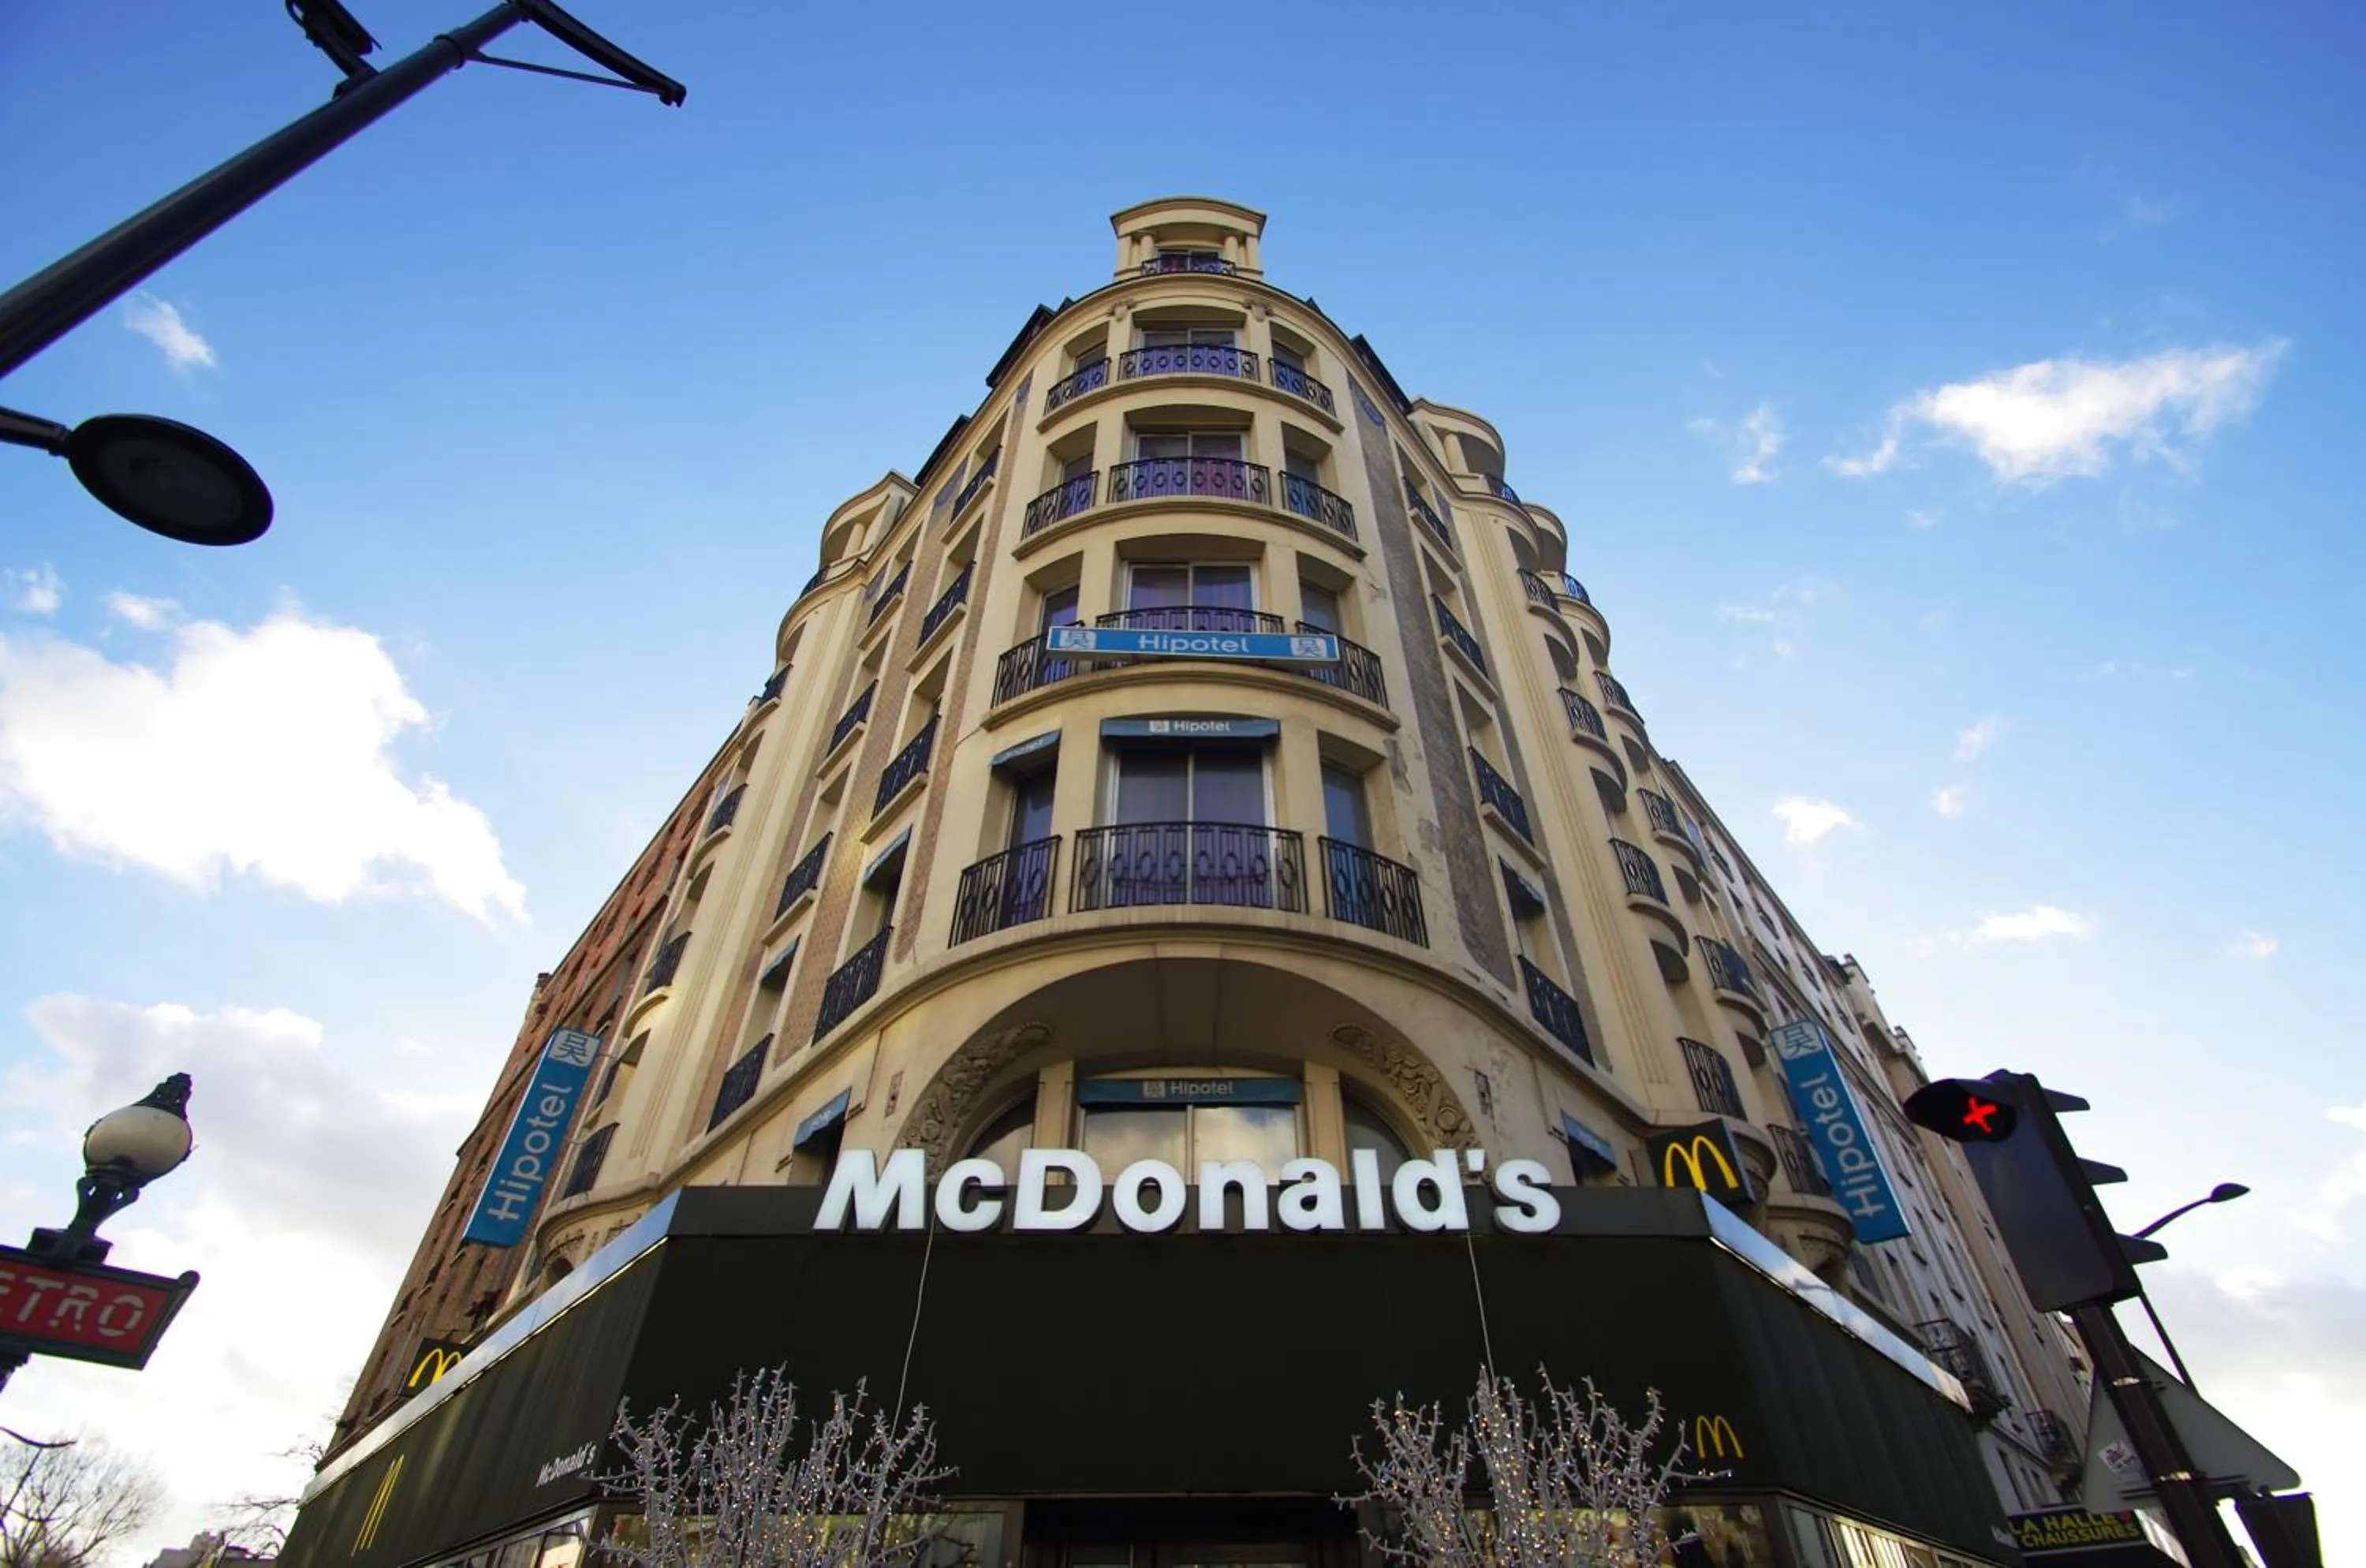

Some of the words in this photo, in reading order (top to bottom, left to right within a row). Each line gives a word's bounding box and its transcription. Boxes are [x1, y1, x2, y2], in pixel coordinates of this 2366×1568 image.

[1137, 634, 1249, 653] Hipotel
[1173, 719, 1231, 732] Hipotel
[1170, 1081, 1234, 1096] Hipotel
[487, 1084, 573, 1221] Hipotel
[1800, 1073, 1886, 1217] Hipotel
[812, 1148, 1562, 1233] McDonald's
[2008, 1518, 2039, 1535] LA
[2021, 1523, 2140, 1548] CHAUSSURES
